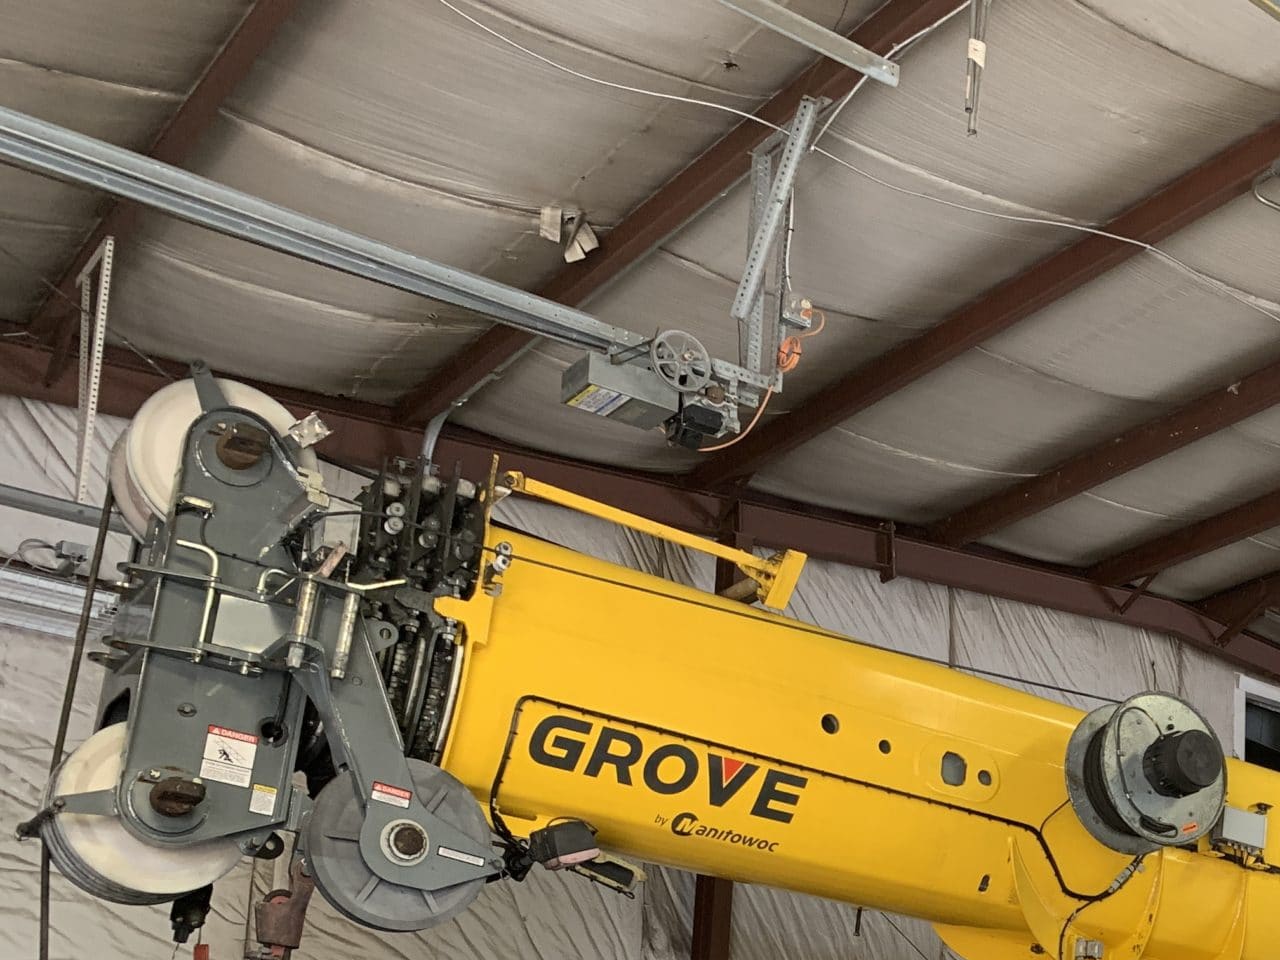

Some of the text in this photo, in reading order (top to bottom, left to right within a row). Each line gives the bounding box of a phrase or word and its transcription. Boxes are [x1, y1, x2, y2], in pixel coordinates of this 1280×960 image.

[221, 729, 255, 743] DANGER
[529, 715, 808, 824] GROVE
[654, 812, 779, 852] by Manitowoc
